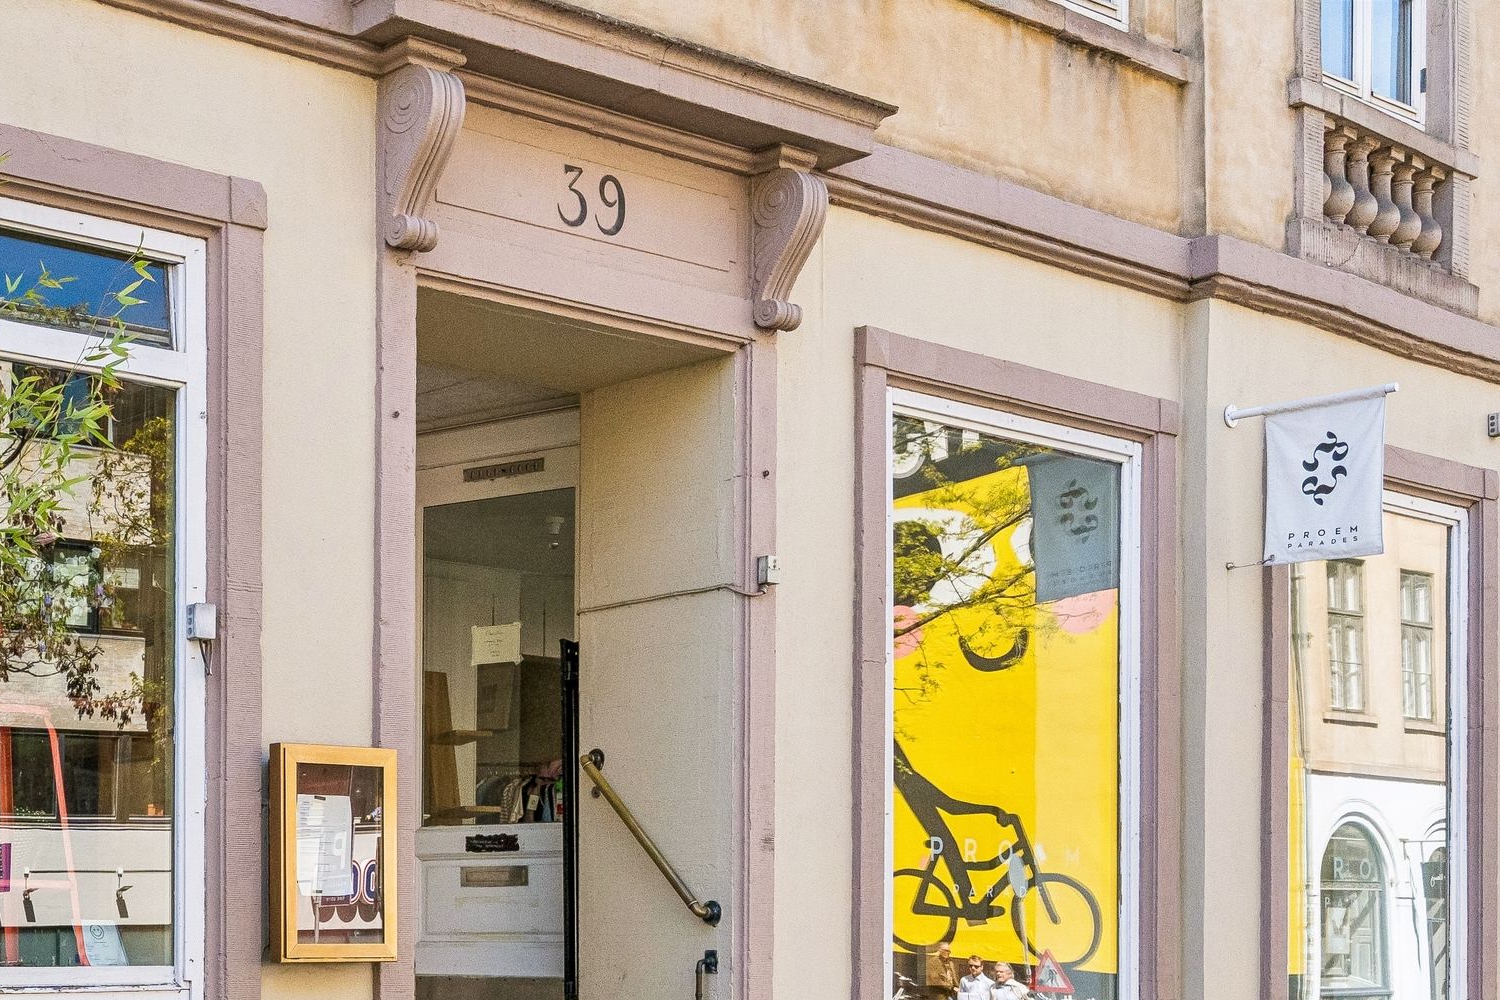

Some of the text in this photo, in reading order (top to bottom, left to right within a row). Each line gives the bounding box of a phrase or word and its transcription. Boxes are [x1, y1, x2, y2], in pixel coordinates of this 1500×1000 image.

[557, 164, 626, 236] 39
[1288, 525, 1358, 540] PROEM
[1287, 535, 1358, 549] PARADES
